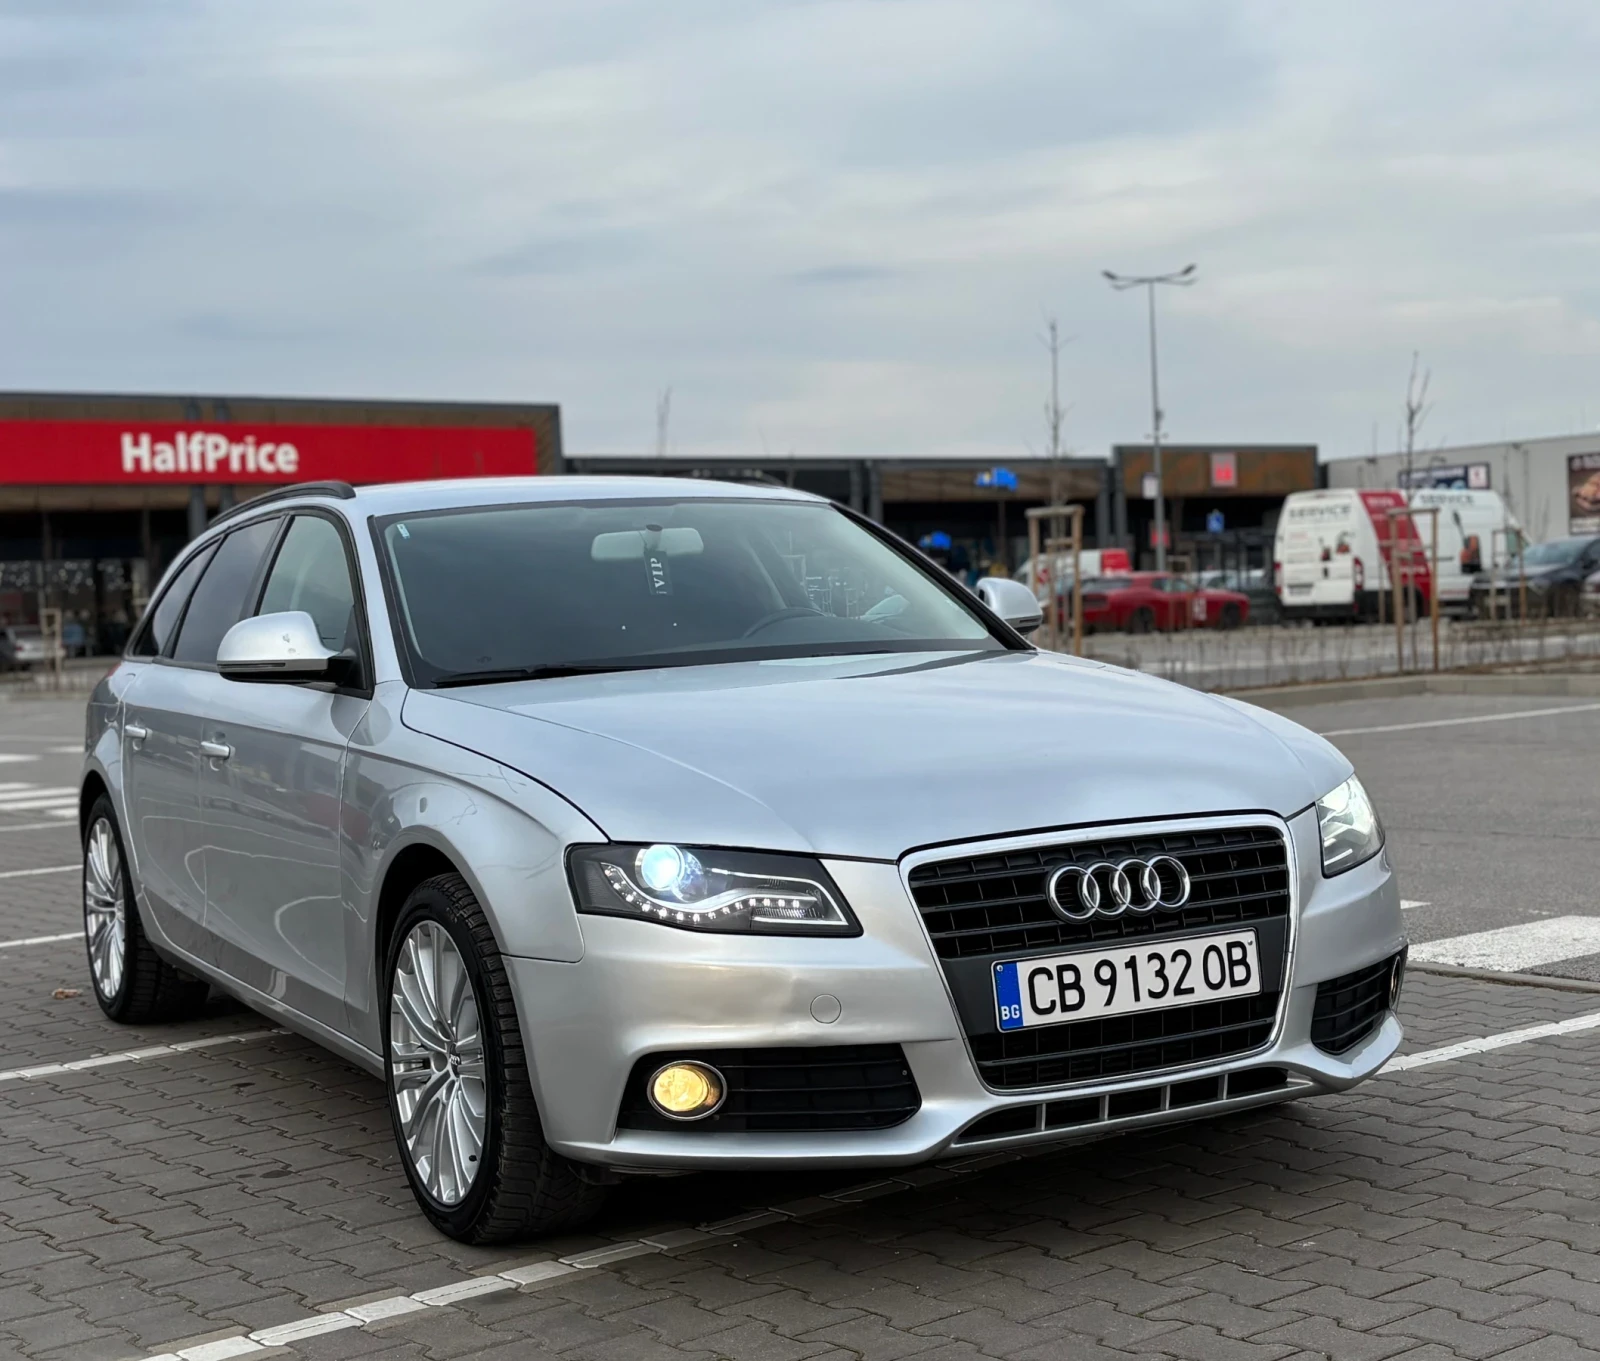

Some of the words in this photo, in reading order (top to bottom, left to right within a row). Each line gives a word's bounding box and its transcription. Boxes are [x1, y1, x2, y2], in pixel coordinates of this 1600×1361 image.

[121, 431, 298, 473] HalfPrice
[1289, 503, 1351, 518] SERVICE
[650, 557, 665, 588] VIP
[1028, 963, 1086, 1016] CB
[1094, 949, 1195, 1007] 9132
[1202, 940, 1252, 991] OB
[1000, 1004, 1021, 1020] BG
